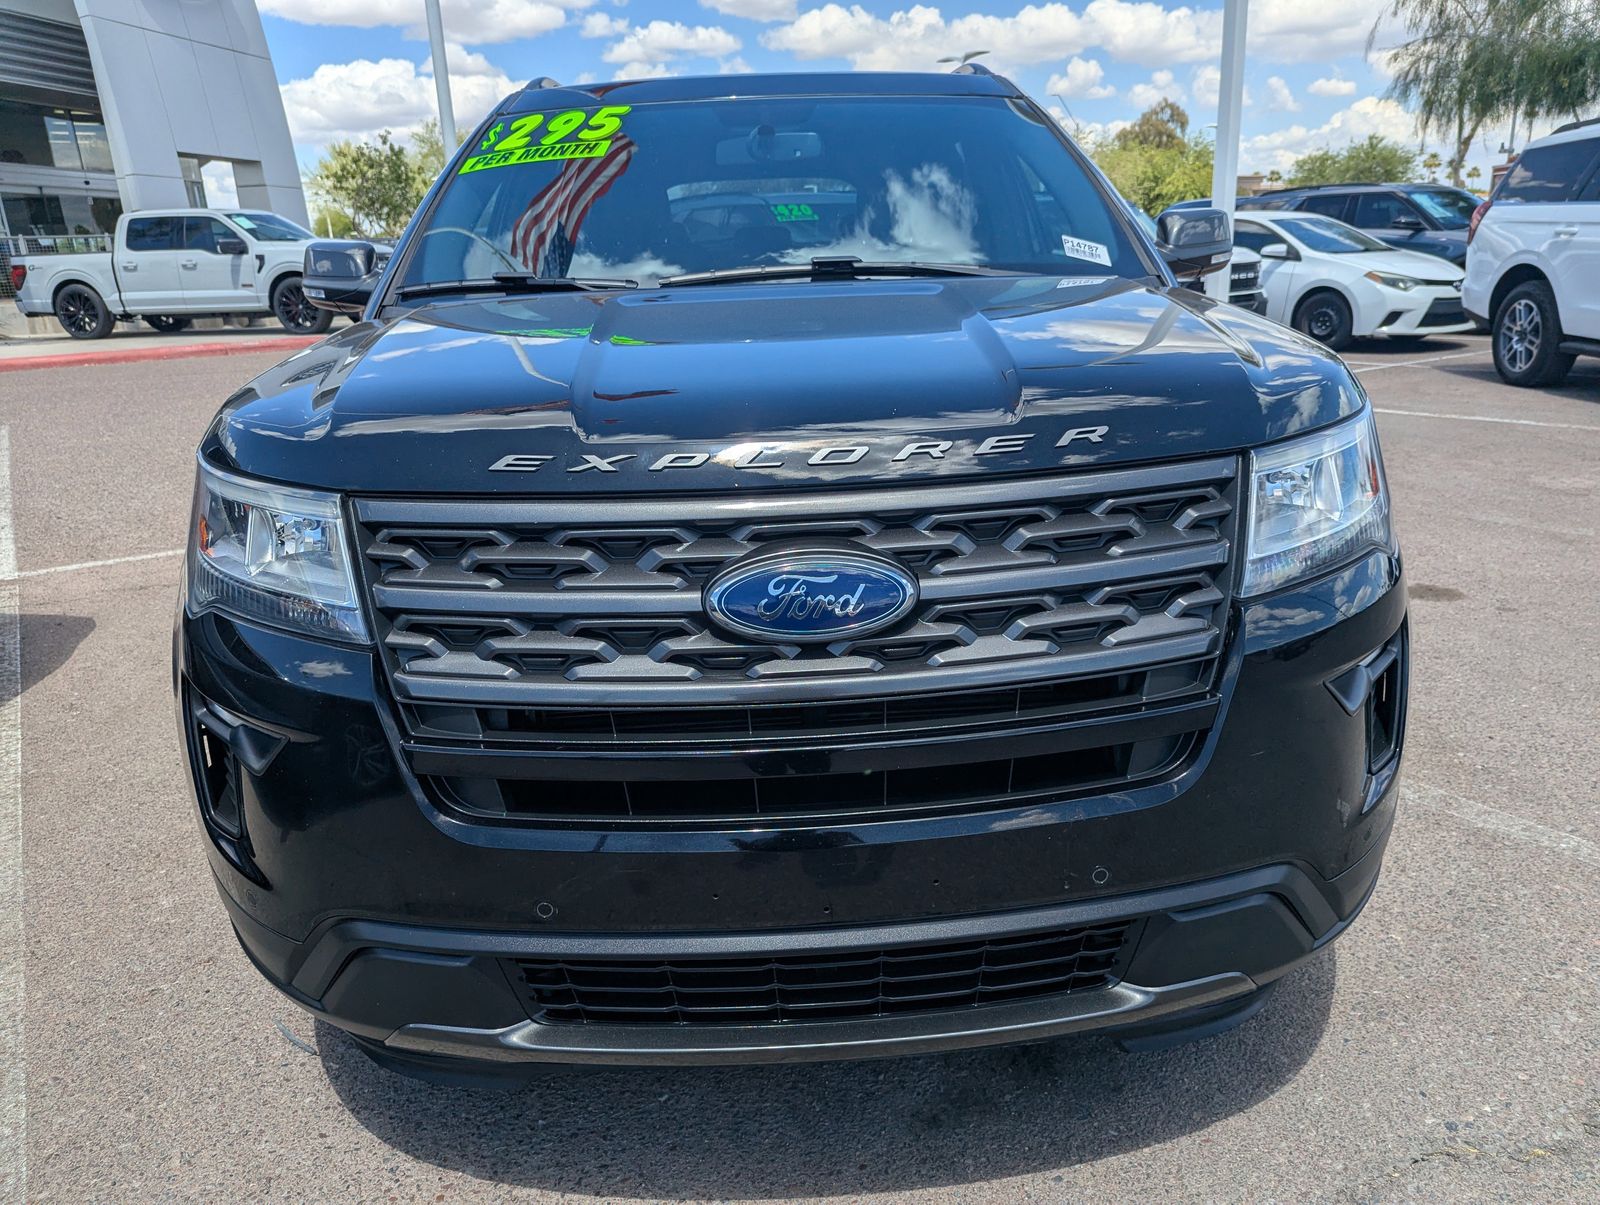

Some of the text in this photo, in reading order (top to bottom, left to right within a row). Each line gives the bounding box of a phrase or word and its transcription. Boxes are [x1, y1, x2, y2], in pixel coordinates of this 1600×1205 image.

[481, 105, 632, 151] $295
[470, 142, 600, 170] PER MONTH
[1063, 238, 1099, 253] P14787
[488, 425, 1109, 473] EXPLORER
[757, 574, 865, 621] Ford
